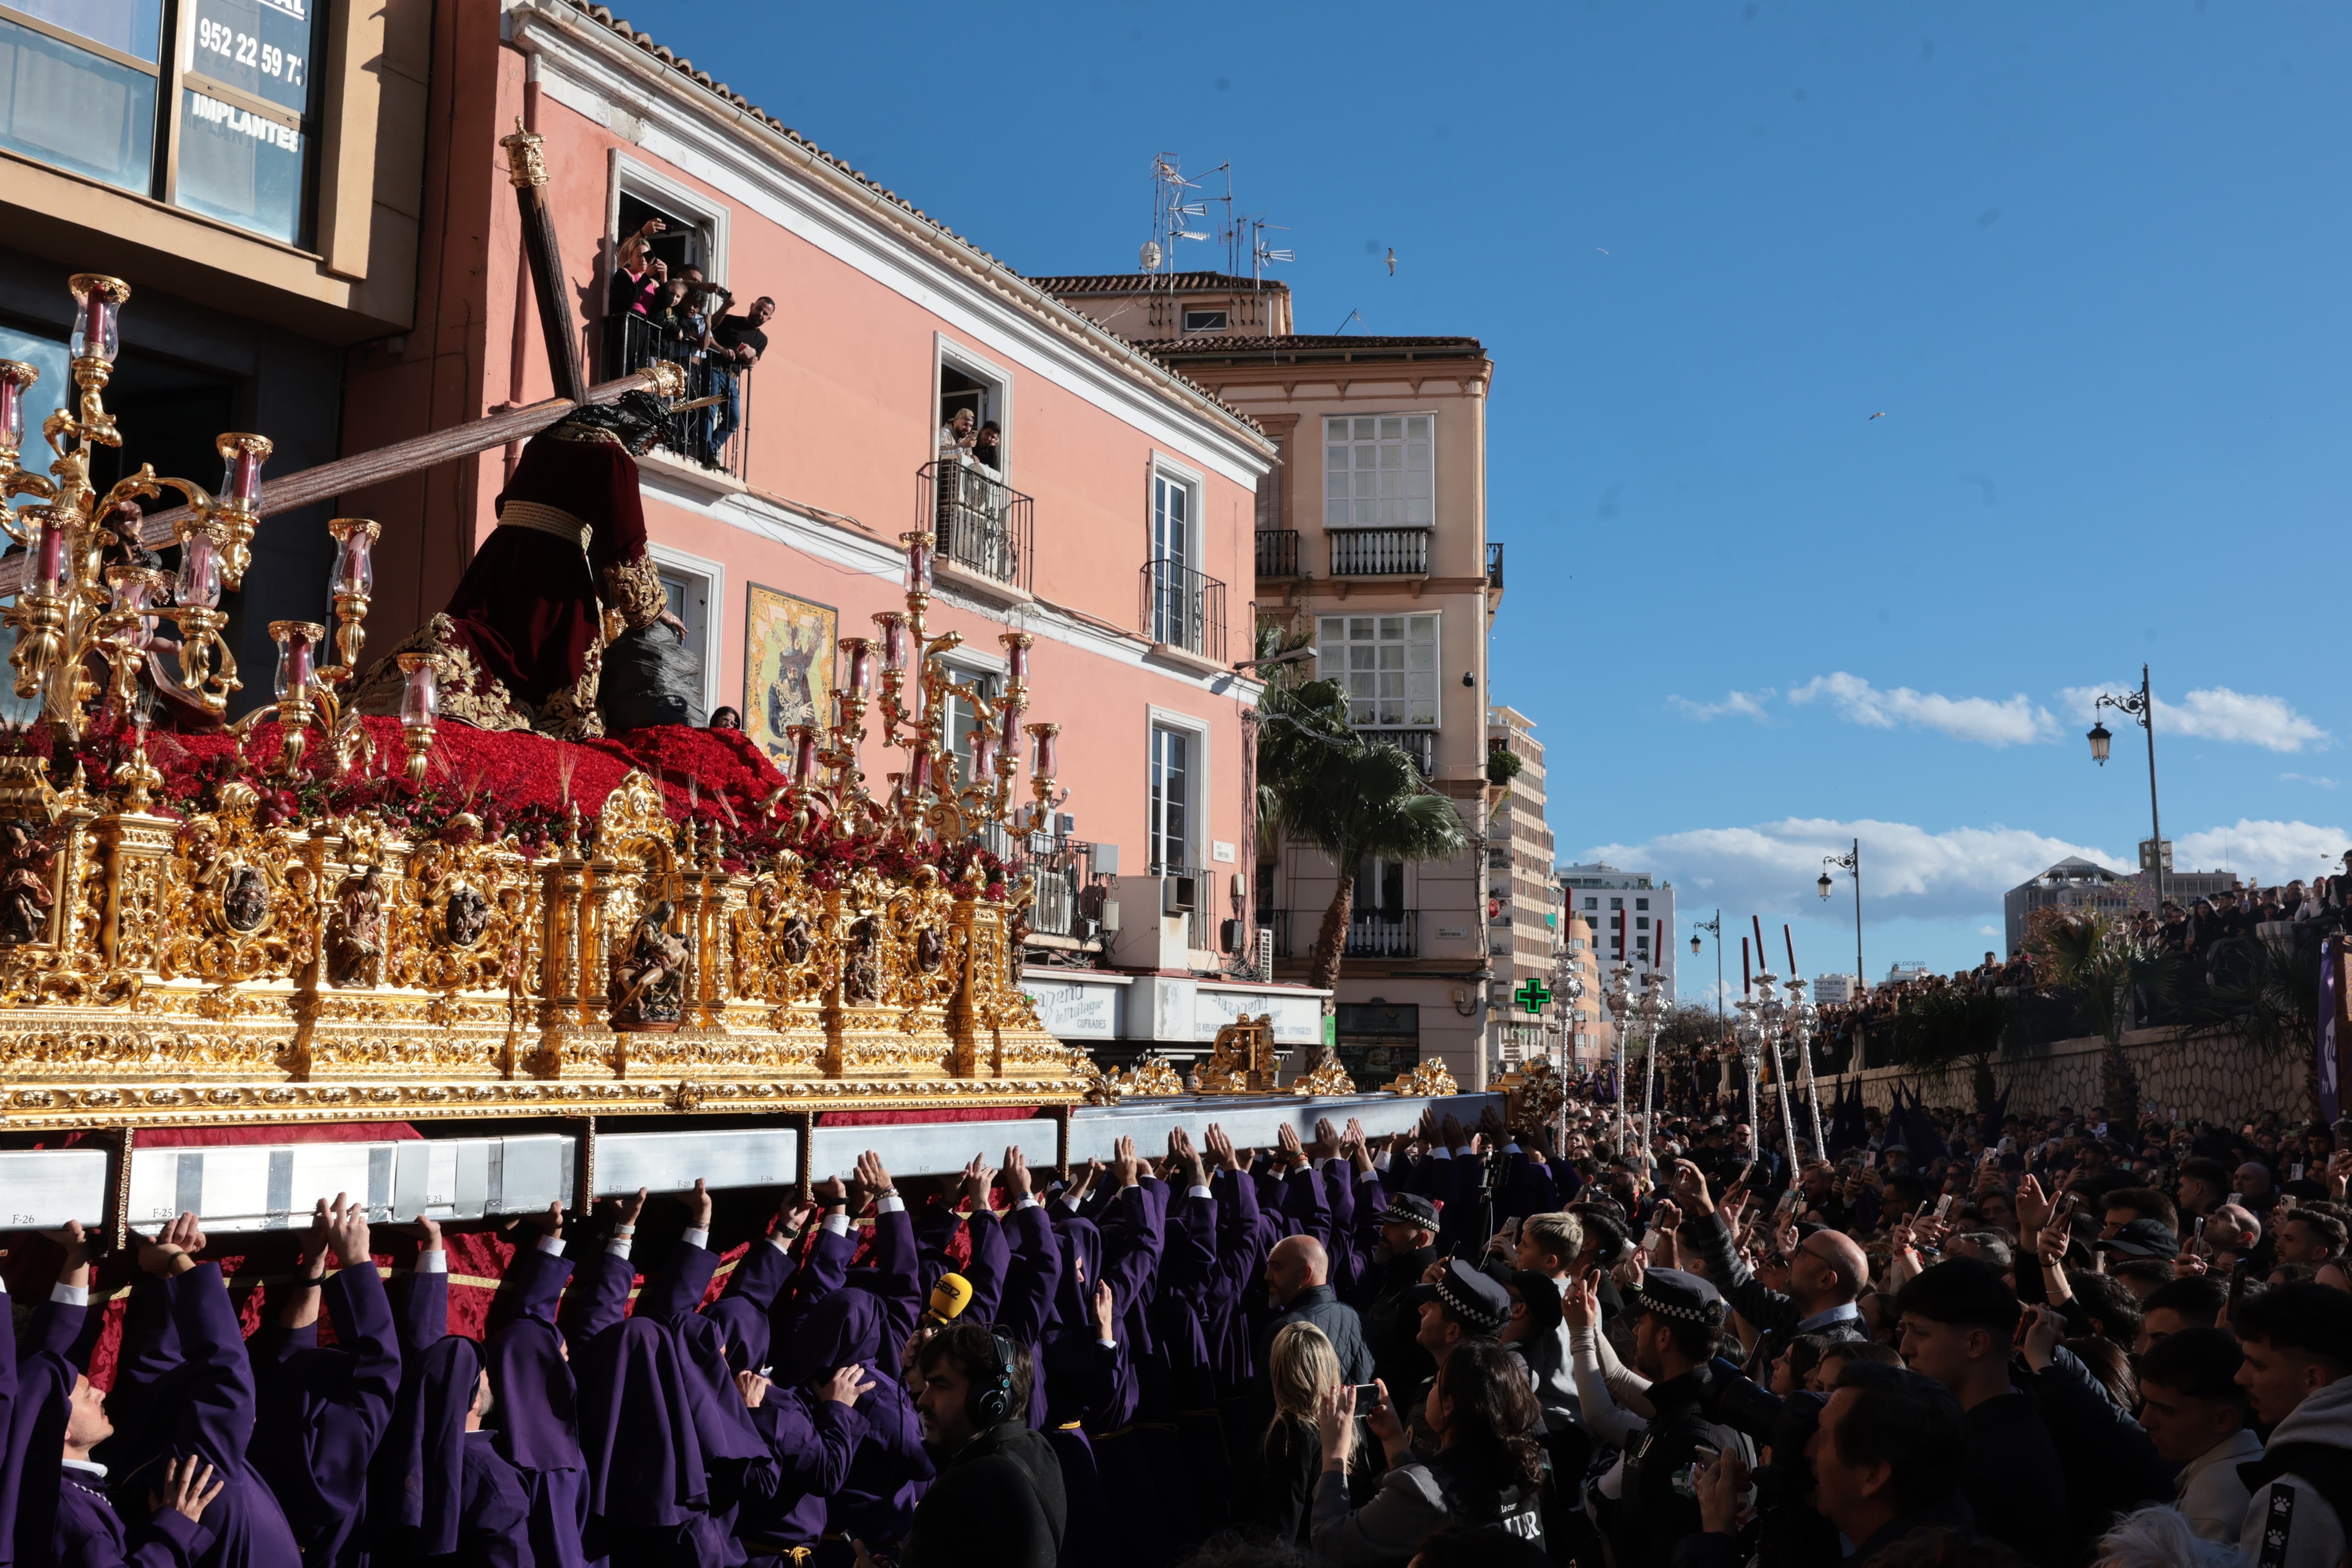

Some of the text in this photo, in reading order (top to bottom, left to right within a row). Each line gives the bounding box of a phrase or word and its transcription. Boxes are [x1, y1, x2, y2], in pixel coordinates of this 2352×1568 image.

[200, 18, 305, 86] 952 22 59 73
[192, 92, 300, 153] IMPLANTES
[1077, 1019, 1106, 1029] COFRADES
[609, 1185, 622, 1193] F-21
[153, 1208, 172, 1217] F-25
[12, 1214, 34, 1224] F-26
[1501, 1505, 1507, 1513] Lo
